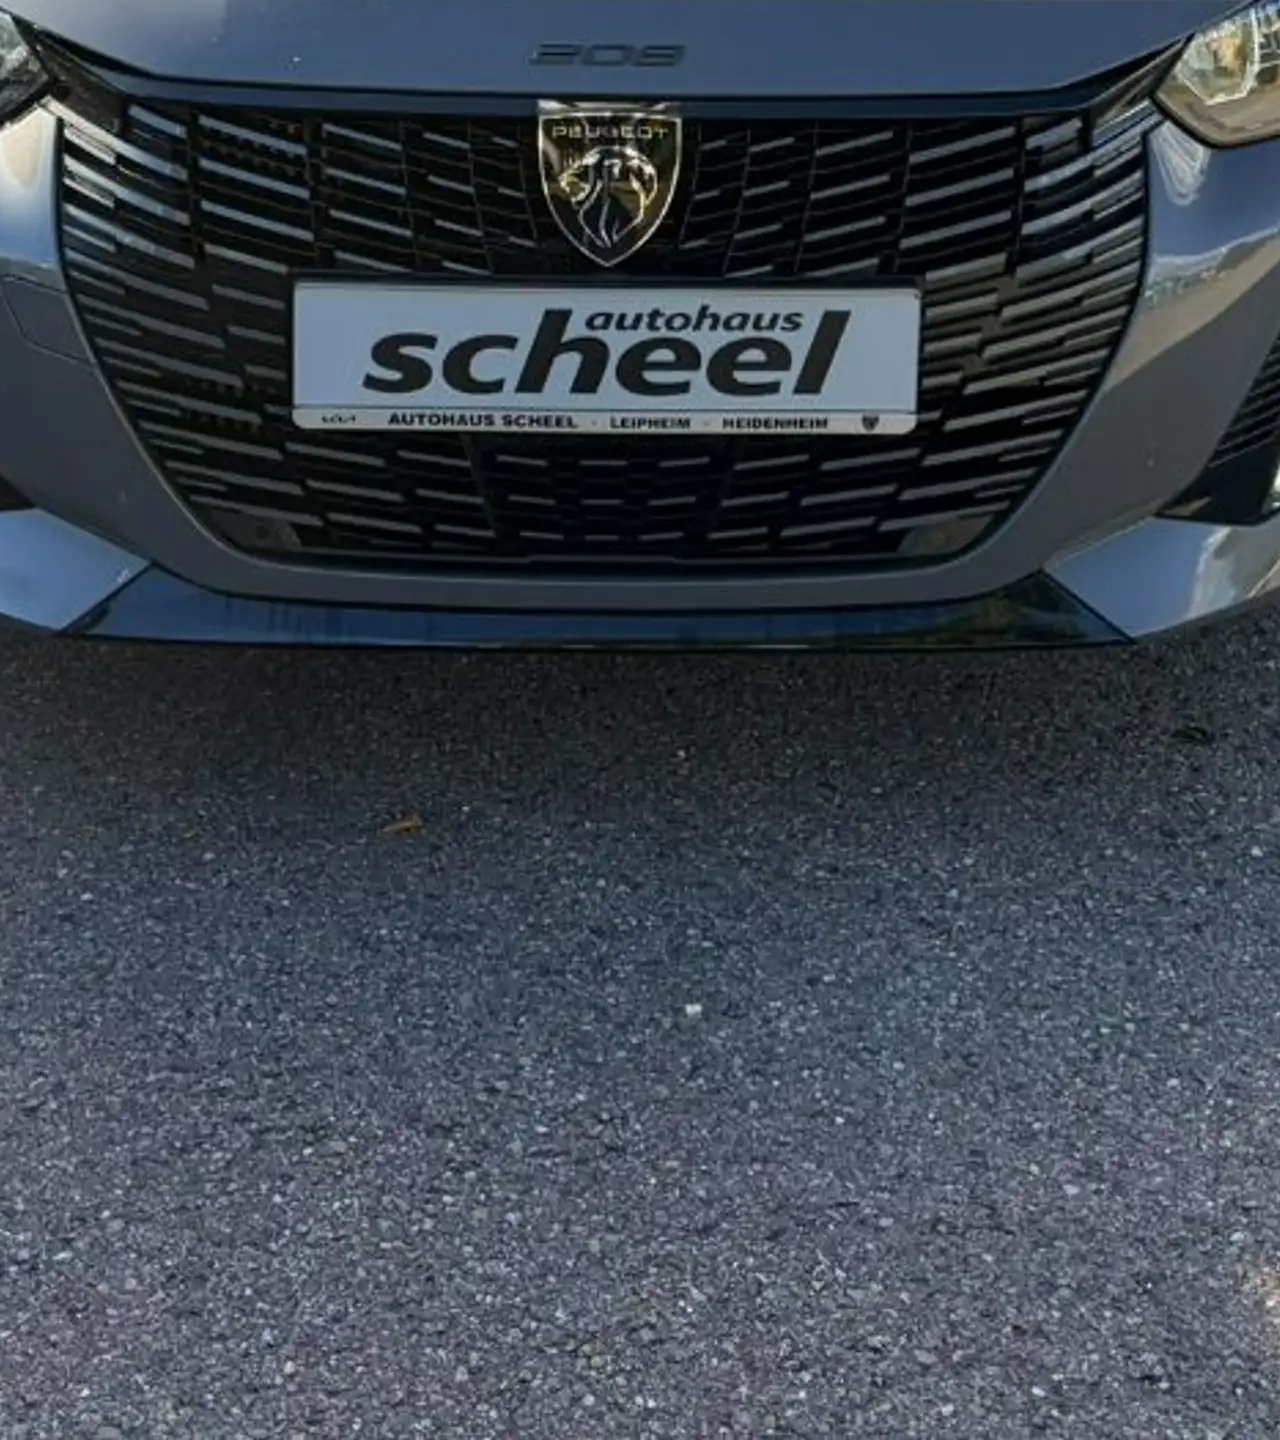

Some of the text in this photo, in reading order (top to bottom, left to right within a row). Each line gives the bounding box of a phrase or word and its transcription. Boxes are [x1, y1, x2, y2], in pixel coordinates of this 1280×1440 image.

[528, 44, 686, 67] 208
[552, 123, 669, 140] PEUGEOT
[585, 304, 804, 332] autohaus
[362, 308, 852, 397] scheel
[387, 413, 496, 427] AUTOHAUS
[502, 414, 578, 428] SCHEEL
[609, 417, 691, 429] LEIPHEIM
[722, 417, 828, 429] HEIDENHEIM
